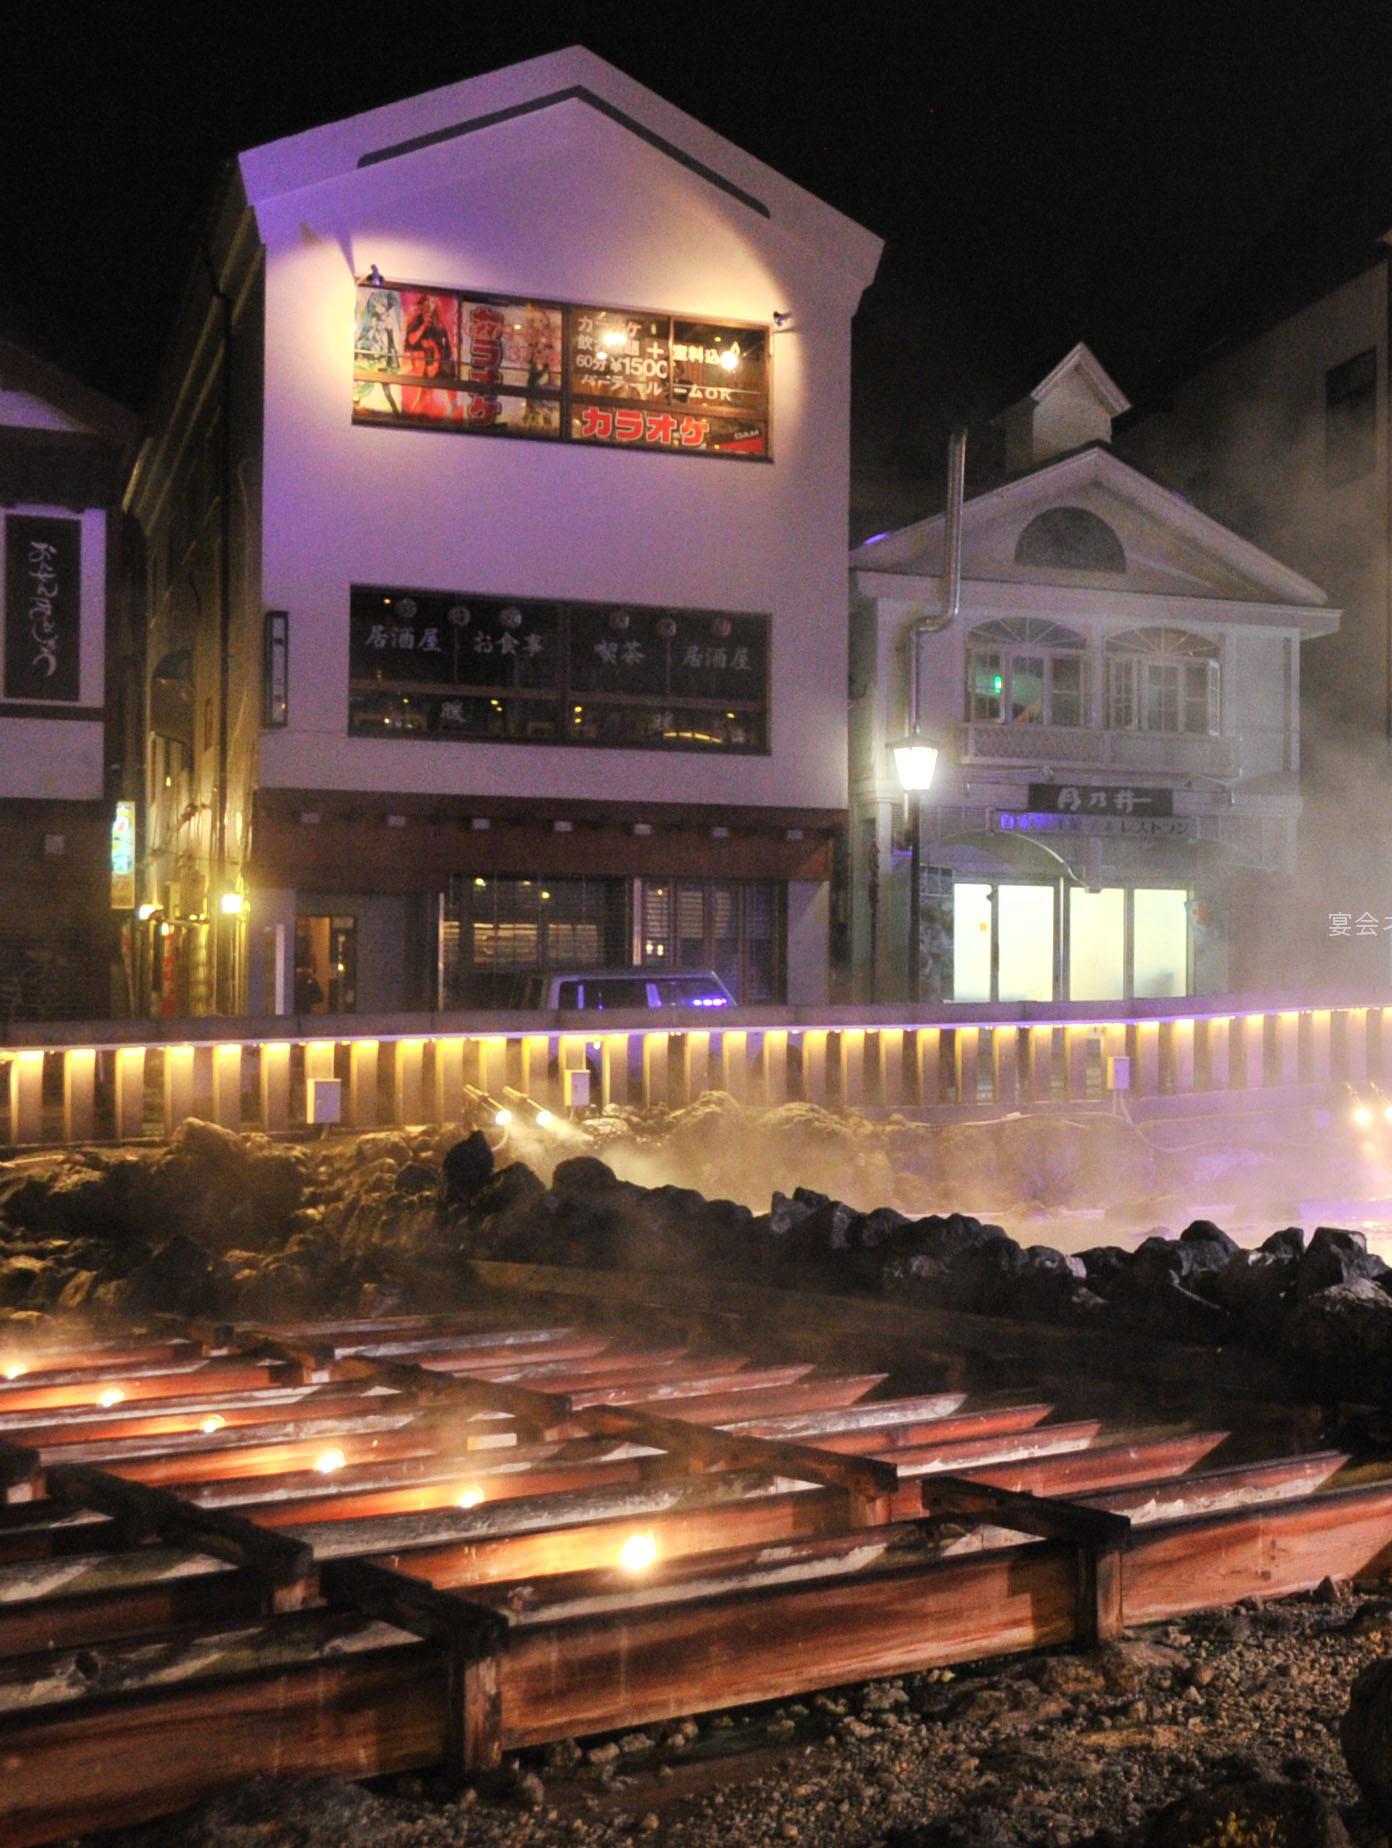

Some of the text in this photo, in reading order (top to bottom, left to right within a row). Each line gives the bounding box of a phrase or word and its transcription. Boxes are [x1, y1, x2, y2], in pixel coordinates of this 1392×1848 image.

[582, 406, 710, 447] カラオケ
[365, 625, 752, 671] 居酒屋 お食事 喫茶 居酒屋
[1057, 787, 1152, 814] 月乃井
